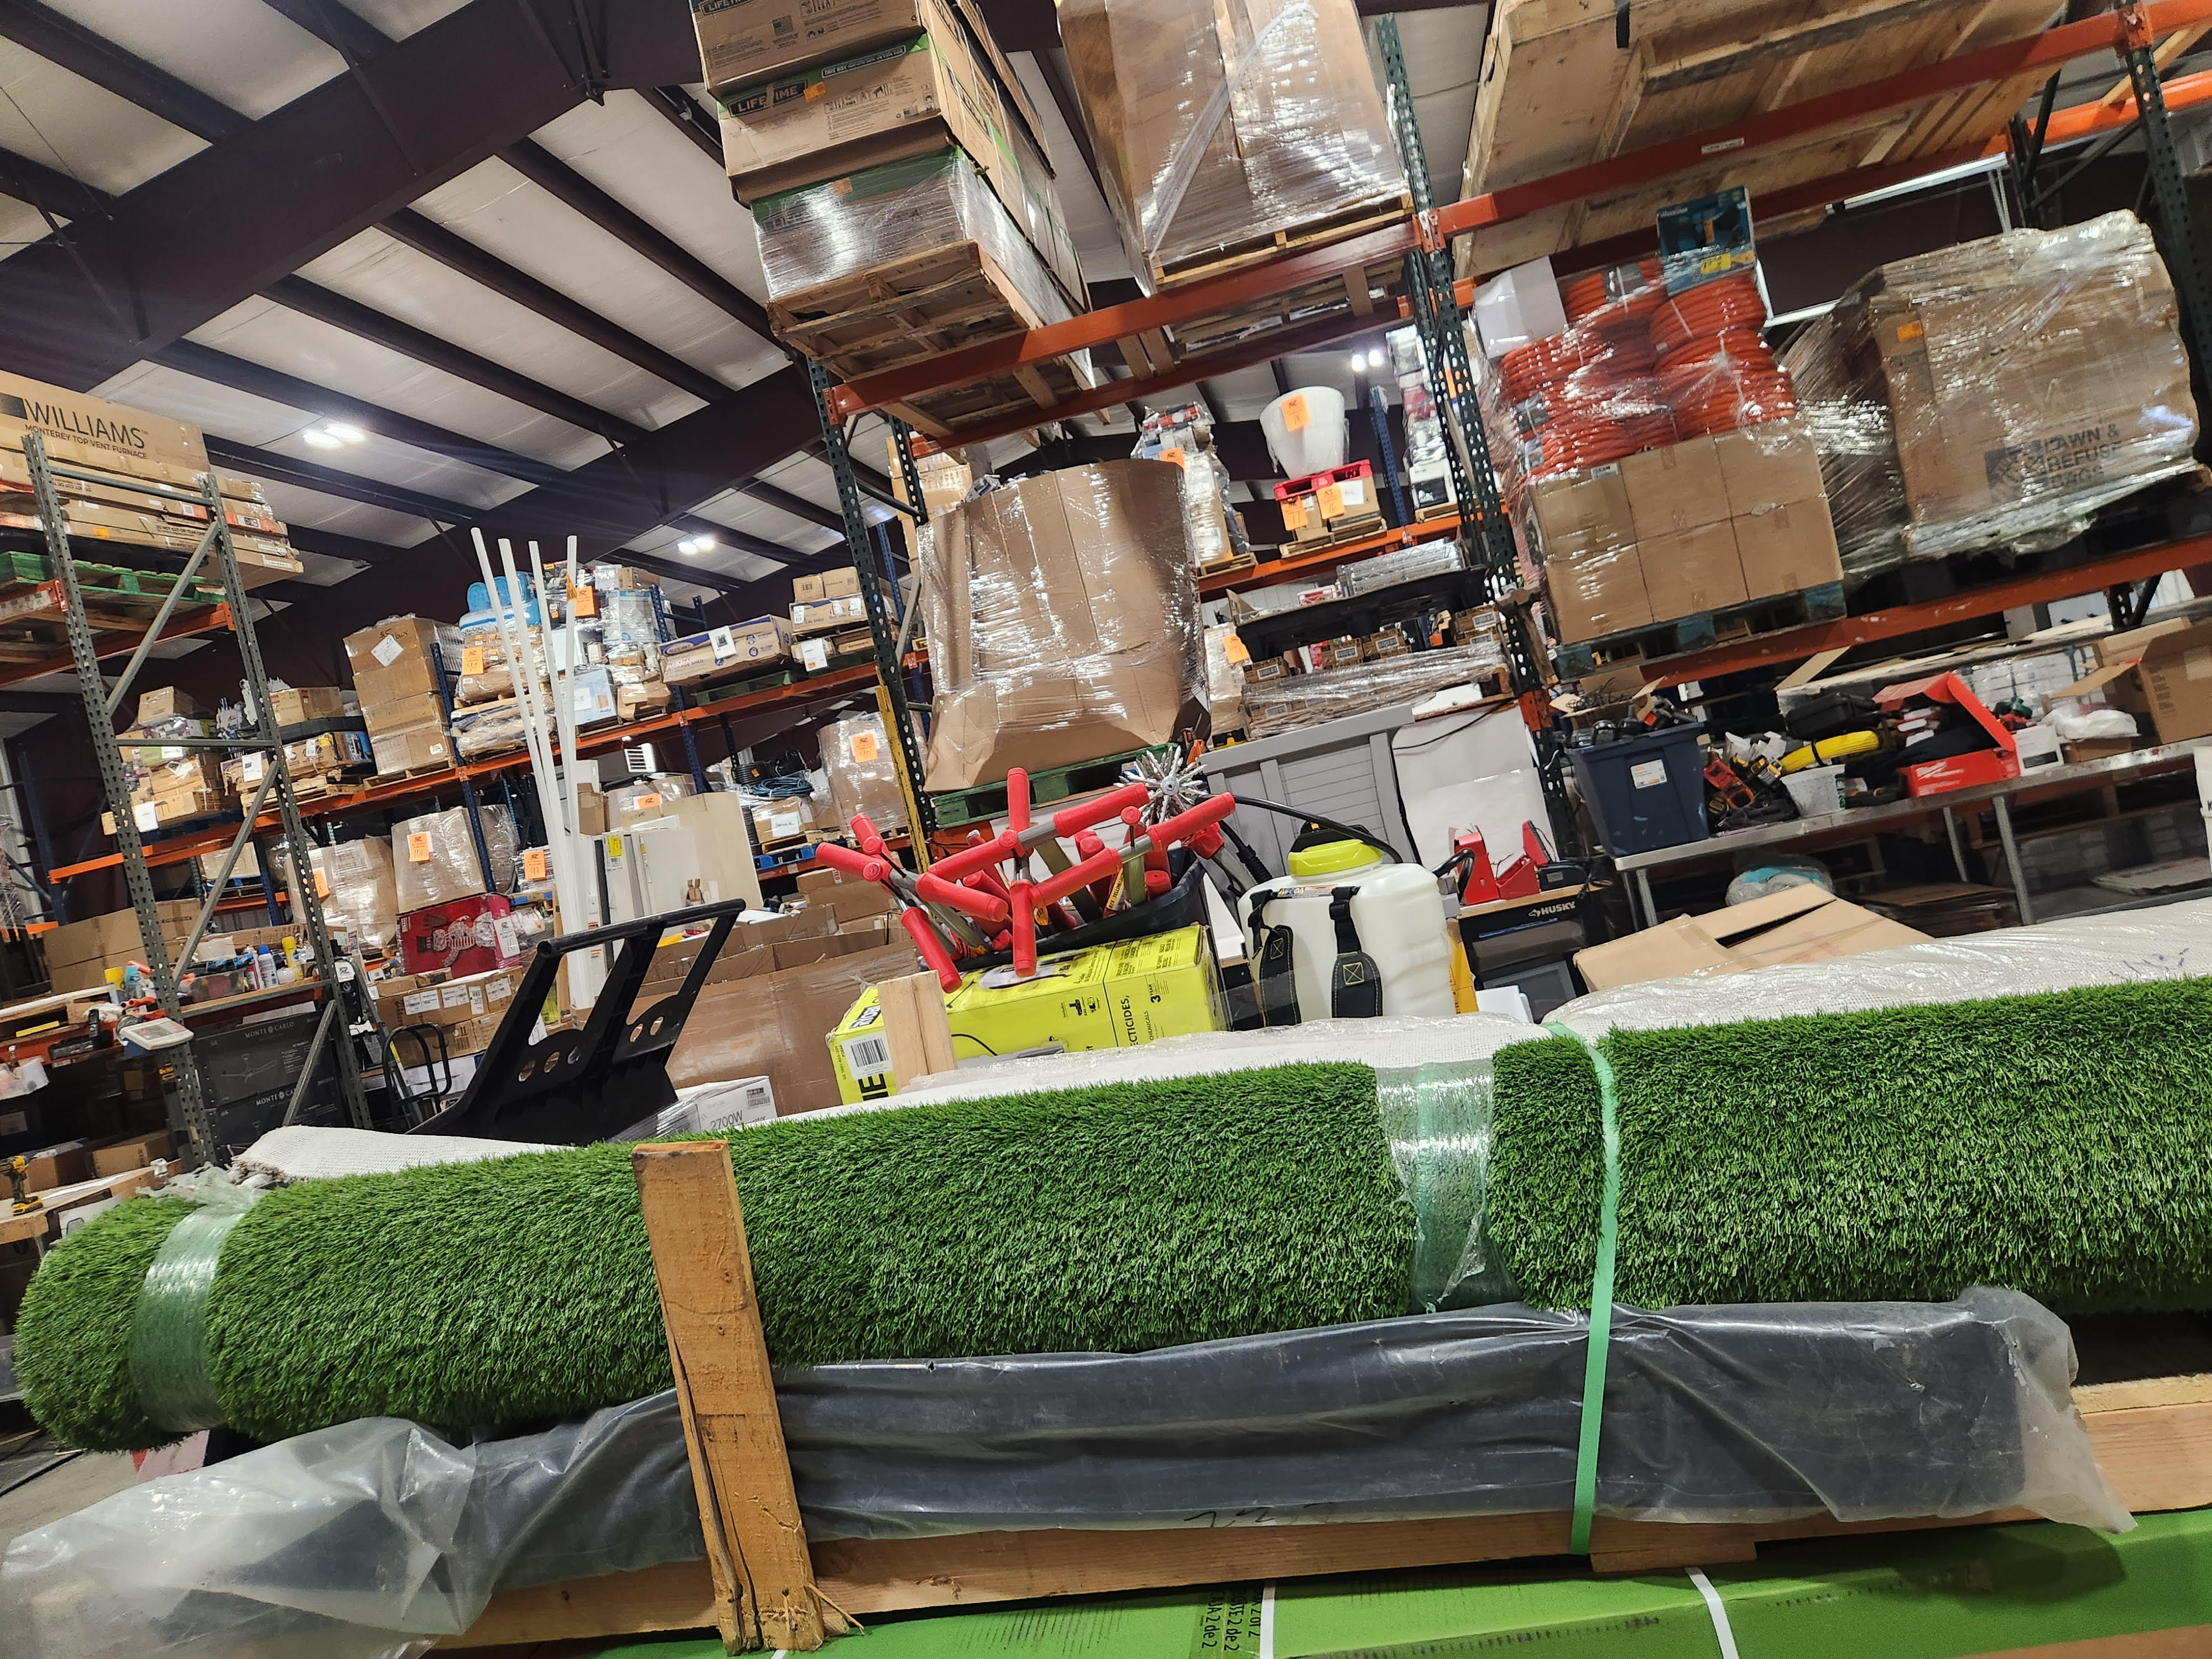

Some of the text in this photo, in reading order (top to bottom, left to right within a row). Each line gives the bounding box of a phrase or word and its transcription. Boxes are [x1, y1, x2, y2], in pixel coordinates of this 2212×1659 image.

[738, 85, 799, 112] LIFEIME
[24, 398, 145, 449] WILLIAMS
[2107, 423, 2119, 439] &
[25, 424, 148, 459] MONTEREY TOP VENT FURNACE
[1541, 901, 1575, 915] HUSKY
[1151, 995, 1161, 1003] 3
[851, 1005, 881, 1029] RYOB
[245, 1022, 294, 1038] MONTE CARLO
[1144, 1010, 1154, 1041] CHEMICALS
[256, 1093, 278, 1106] MONTE
[711, 1110, 743, 1130] 2700W
[1203, 1625, 1220, 1639] de
[1225, 1629, 1242, 1642] de
